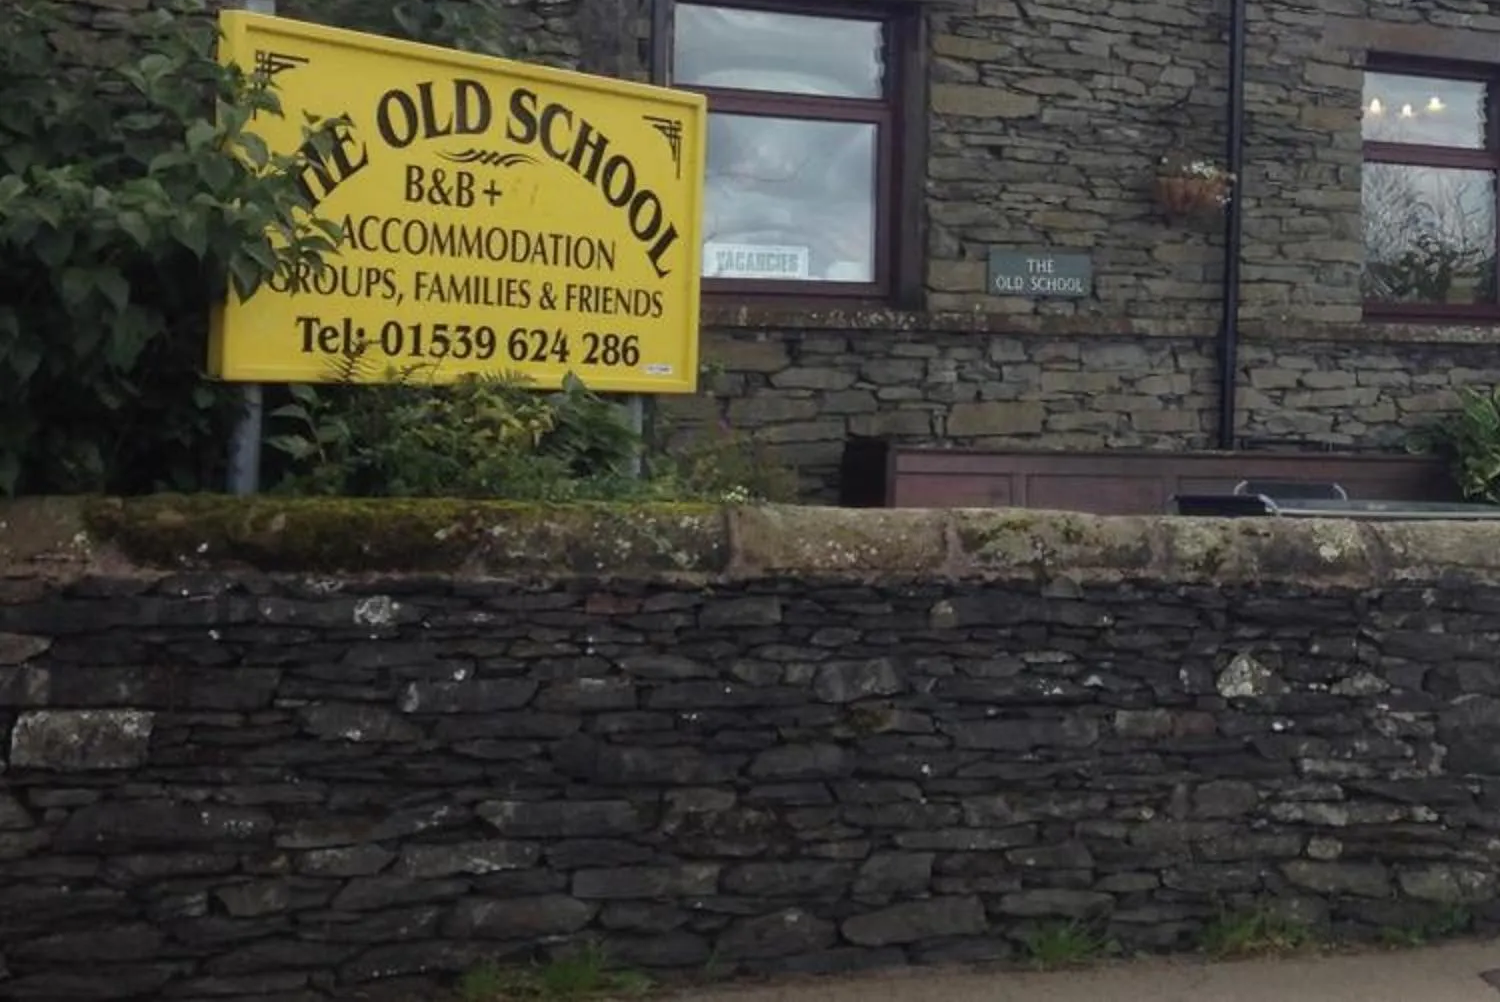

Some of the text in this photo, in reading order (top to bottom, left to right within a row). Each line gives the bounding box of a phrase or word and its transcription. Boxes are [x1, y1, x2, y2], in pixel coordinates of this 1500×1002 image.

[286, 78, 680, 279] HE OLD SCHOOL
[340, 214, 618, 273] ACCOMMODATION
[715, 249, 800, 274] VACANCIES
[1025, 258, 1055, 274] THE
[268, 259, 664, 319] GROUPS, FAMILIES & FRIENDS
[995, 275, 1085, 293] OLD SCHOOL
[296, 316, 640, 367] Tel: 01539 624 286
